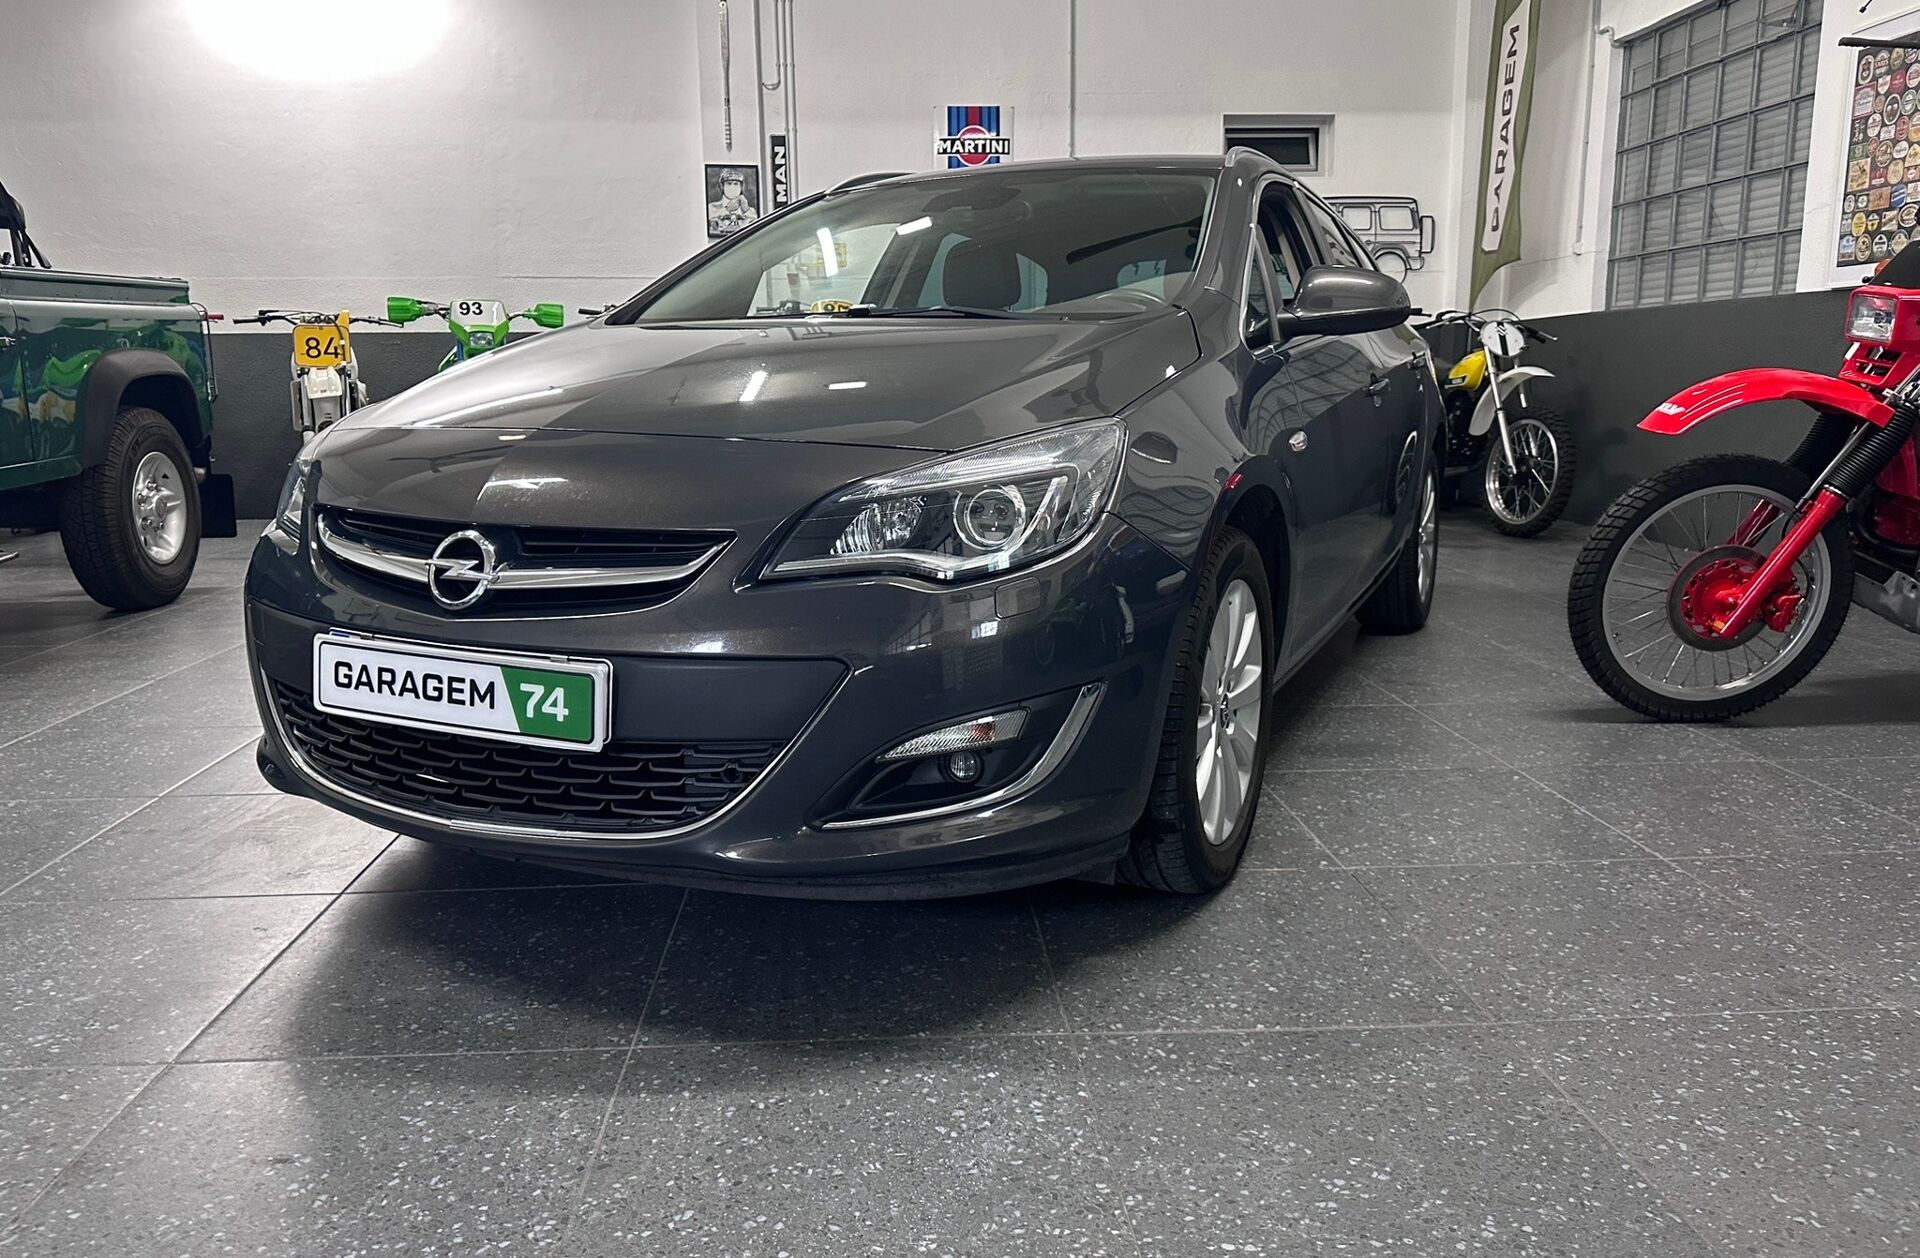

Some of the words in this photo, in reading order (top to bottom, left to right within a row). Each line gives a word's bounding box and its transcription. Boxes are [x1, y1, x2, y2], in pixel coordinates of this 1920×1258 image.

[938, 139, 1009, 153] MARTINI
[774, 146, 787, 203] MAN
[459, 301, 483, 316] 93
[305, 336, 344, 359] 84
[333, 660, 496, 710] GARAGEM
[519, 683, 569, 722] 74
